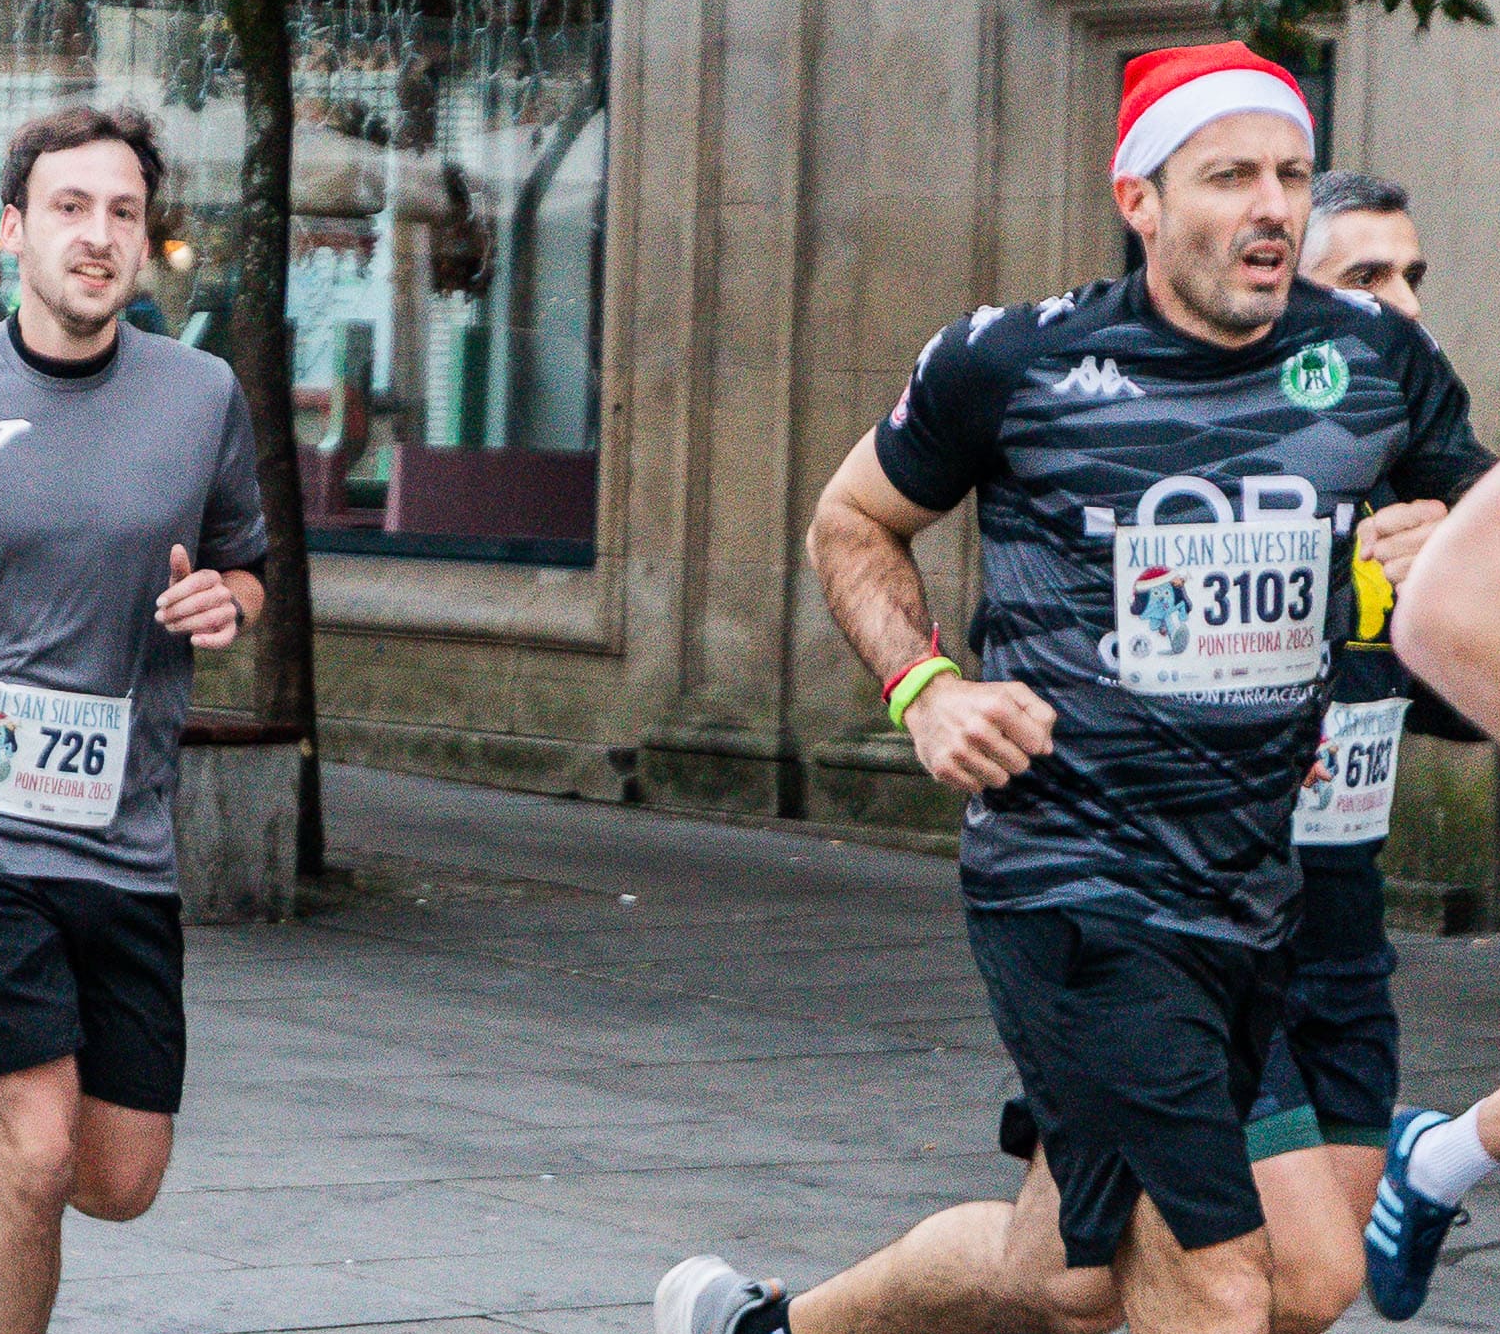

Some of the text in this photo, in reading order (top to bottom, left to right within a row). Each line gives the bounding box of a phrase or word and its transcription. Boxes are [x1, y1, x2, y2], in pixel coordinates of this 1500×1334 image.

[1127, 530, 1321, 568] XLII SAN SILVESTRE
[1202, 566, 1314, 625] 3103
[1198, 626, 1315, 657] PONTEVEDRA 2025
[12, 692, 46, 721] SAN
[52, 697, 121, 730] SILVESTRE
[35, 726, 108, 776] 726
[14, 771, 114, 801] PONTEVEDRA 2025
